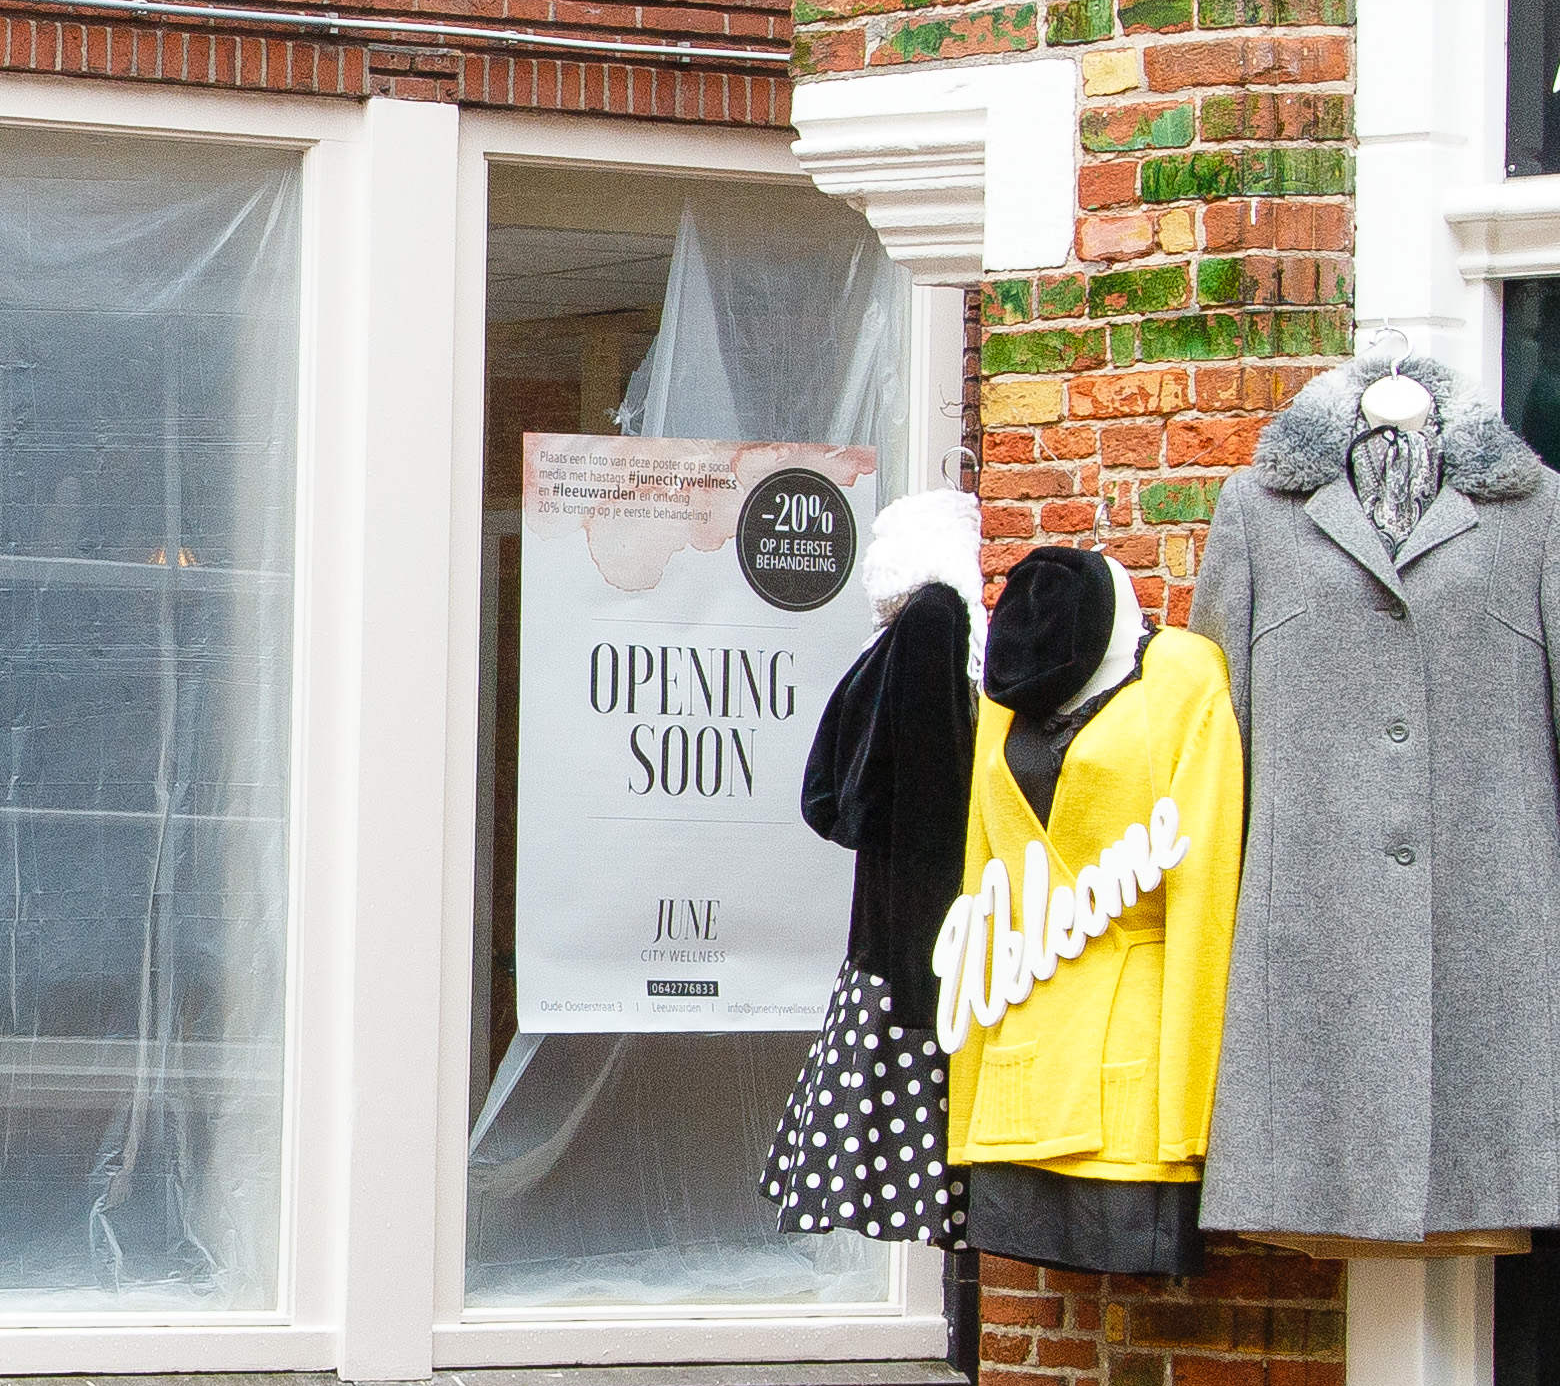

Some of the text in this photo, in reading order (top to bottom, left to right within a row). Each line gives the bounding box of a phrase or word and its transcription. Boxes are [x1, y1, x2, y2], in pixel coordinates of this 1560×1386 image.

[539, 451, 732, 473] Plaats een foto van deze poster op je social
[539, 469, 737, 490] media met hastags #junecitywellness
[538, 483, 690, 505] en #leeuwarden en ontvang
[538, 501, 712, 522] 20% korting op je eerste behandeling!
[762, 493, 833, 534] -20%
[760, 538, 832, 556] OP JE EERSTE
[756, 554, 836, 572] BEHANDELING
[590, 642, 797, 720] OPENING
[628, 724, 757, 797] SOON
[653, 899, 720, 943] JUNE
[641, 950, 726, 963] CITY WELLNESS
[651, 983, 714, 994] 0642776833
[540, 1001, 825, 1016] Oude Oosterstraat 3 Leeuwarden info@junecitywellness.nl
